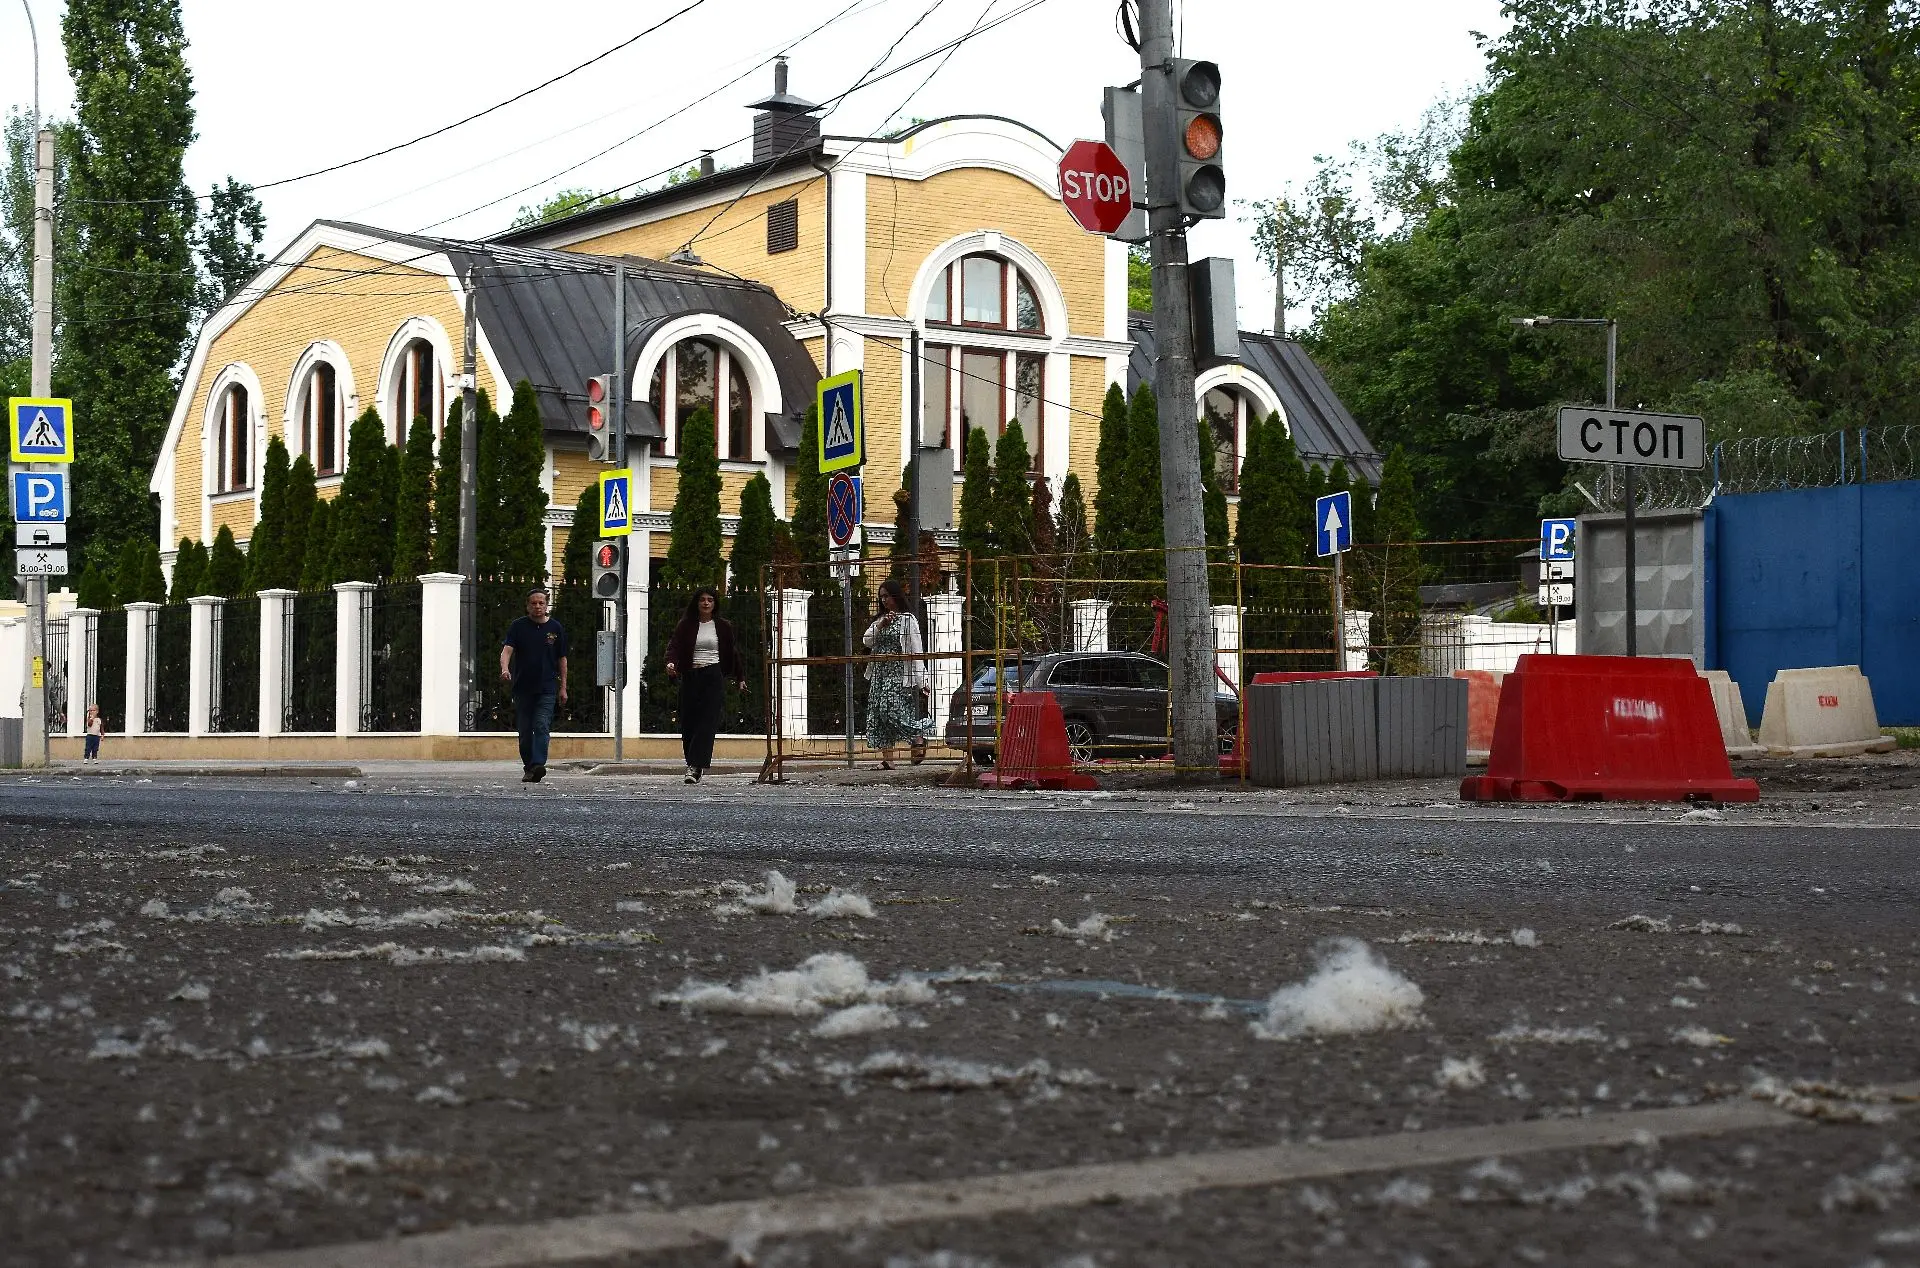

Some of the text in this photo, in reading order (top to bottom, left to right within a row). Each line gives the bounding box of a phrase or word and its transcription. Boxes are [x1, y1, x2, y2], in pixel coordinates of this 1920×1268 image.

[1064, 169, 1128, 203] STOP
[1580, 417, 1684, 460] СТОП
[28, 478, 56, 517] P
[1549, 523, 1570, 556] P
[20, 563, 66, 573] 8.00-19.00
